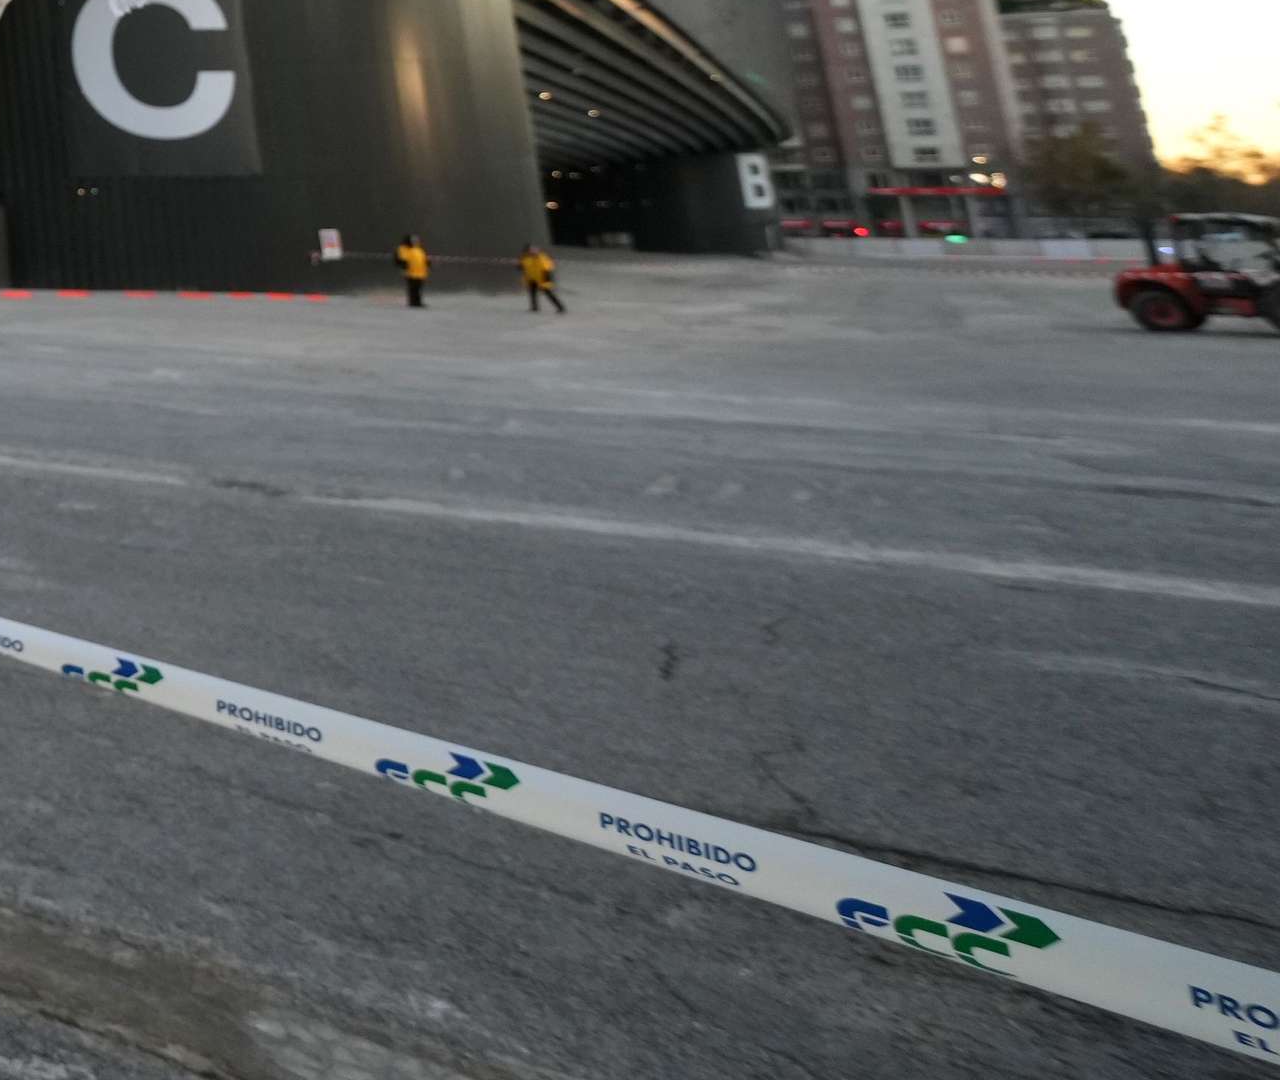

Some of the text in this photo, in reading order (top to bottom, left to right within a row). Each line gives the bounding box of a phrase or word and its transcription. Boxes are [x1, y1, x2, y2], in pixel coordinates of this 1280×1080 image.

[735, 152, 776, 208] B
[216, 699, 322, 742] PROHIBIDO
[599, 811, 757, 872] PROHIBIDO
[626, 844, 741, 886] EL PASO
